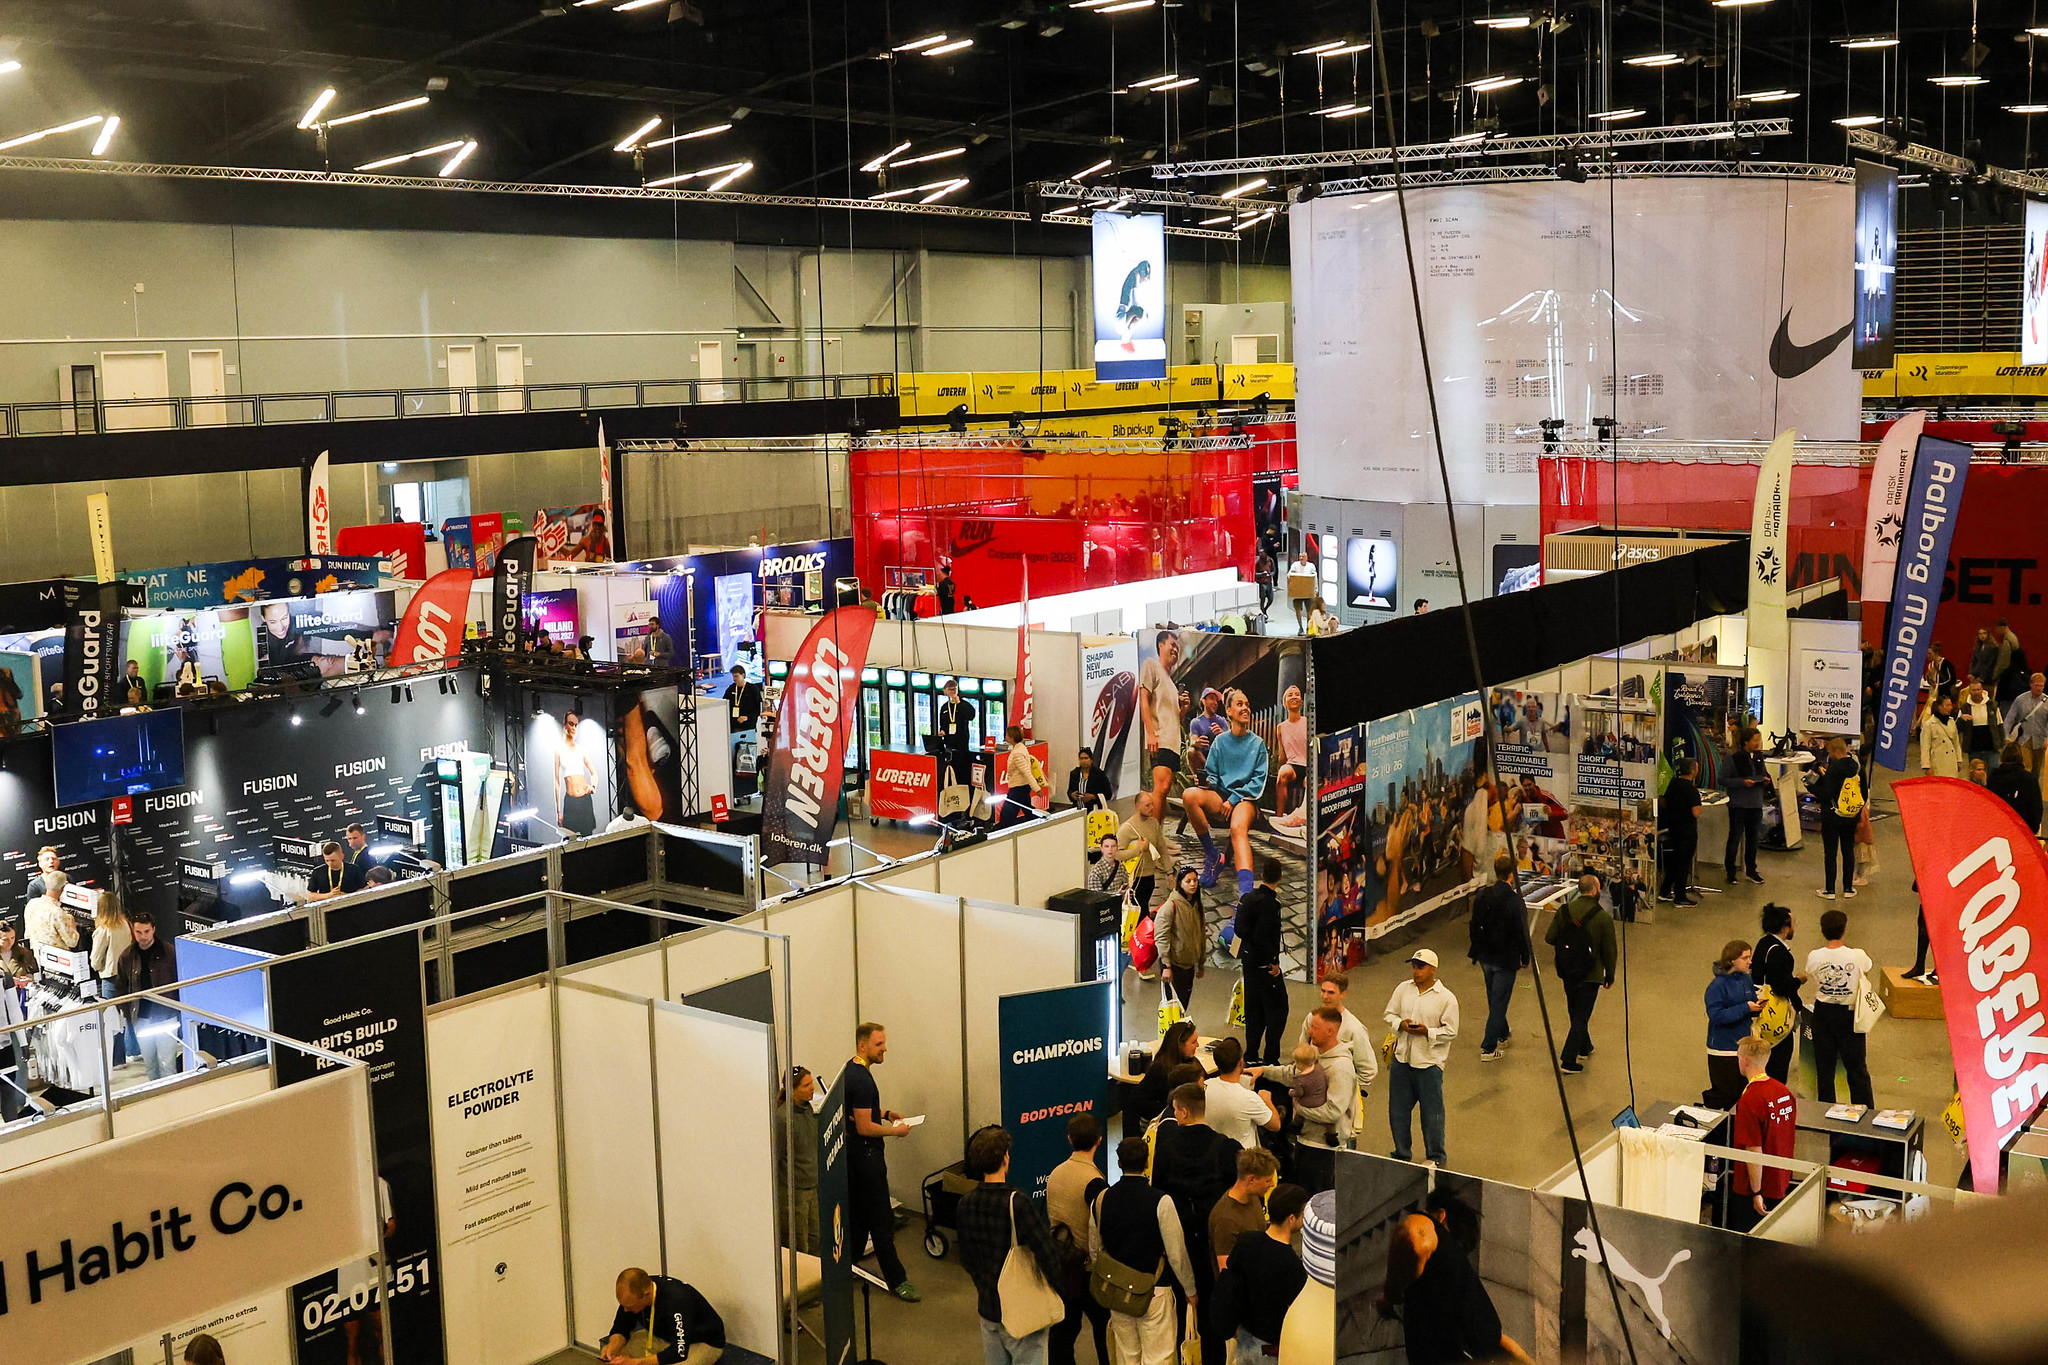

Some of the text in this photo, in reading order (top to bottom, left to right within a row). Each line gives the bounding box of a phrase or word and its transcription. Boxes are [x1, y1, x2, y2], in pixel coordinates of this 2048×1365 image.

[1996, 366, 2048, 377] LØBEREN
[937, 387, 966, 397] LØBEREN
[1113, 424, 1154, 437] Bib pick-up
[959, 520, 995, 541] RUN
[1626, 546, 1660, 560] asics
[328, 561, 370, 571] RUN IN ITALY
[758, 552, 827, 578] BROOKS
[1880, 460, 1956, 750] Aalborg Marathon
[296, 608, 363, 628] liiteGuard
[544, 621, 574, 632] MILANO
[151, 625, 226, 648] liiteGuard
[1086, 650, 1114, 663] SHAPING
[1086, 662, 1100, 672] NEW
[1086, 668, 1114, 680] FUTURES
[1808, 690, 1825, 698] Selv
[1840, 692, 1854, 700] lille
[1808, 698, 1851, 708] bevægelse
[1824, 708, 1848, 716] skabe
[1808, 714, 1848, 726] forandring
[785, 637, 850, 830] LØBEREN
[420, 740, 468, 762] FUSION
[1498, 744, 1531, 754] TERRIFIC,
[1496, 754, 1546, 766] SUSTAINABLE
[1579, 754, 1606, 763] SHORT
[335, 756, 386, 779] FUSION
[1498, 765, 1552, 776] ORGANISATION
[1579, 765, 1622, 776] DISTANCES
[243, 773, 298, 796] FUSION
[876, 767, 931, 788] LØBEREN
[1579, 776, 1616, 786] BETWEEN
[1579, 786, 1604, 796] FINISH
[1622, 790, 1644, 799] EXPO
[145, 790, 204, 814] FUSION
[34, 808, 96, 834] FUSION
[384, 822, 410, 835] FUSION
[280, 842, 307, 858] FUSION
[184, 864, 210, 879] FUSION
[323, 1008, 372, 1026] Good Habit Co.
[356, 1018, 398, 1041] BUILD
[380, 1070, 395, 1080] best
[448, 1068, 534, 1109] ELECTROLYTE
[464, 1090, 520, 1120] POWDER
[1020, 1099, 1094, 1124] BODYSCAN
[466, 1132, 522, 1158] Cleaner than tablets
[466, 1182, 478, 1194] Mild
[479, 1180, 490, 1189] and
[492, 1172, 511, 1184] natural
[512, 1167, 526, 1176] taste
[464, 1200, 532, 1231] Fast absorption of water
[26, 1206, 196, 1304] Habit
[210, 1182, 304, 1235] Co.
[178, 1324, 207, 1340] creatine
[208, 1318, 224, 1328] with
[225, 1314, 235, 1322] no
[236, 1306, 258, 1318] extras
